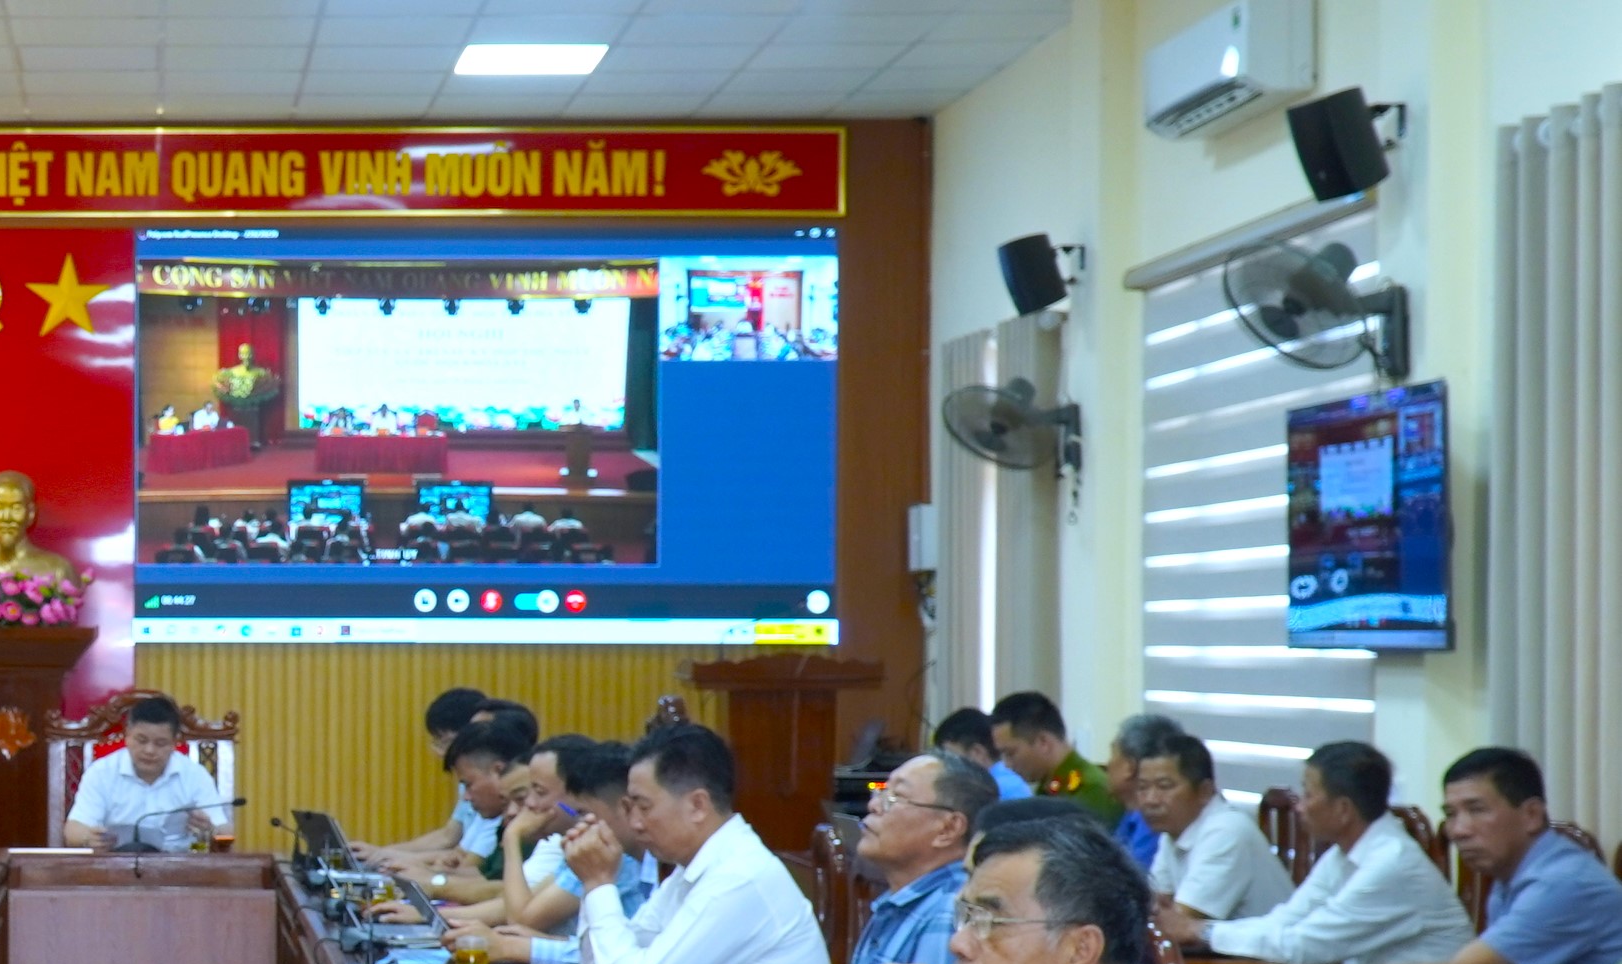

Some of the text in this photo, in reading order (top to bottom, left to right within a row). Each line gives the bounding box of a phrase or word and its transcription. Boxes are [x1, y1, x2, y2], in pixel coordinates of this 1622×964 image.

[65, 151, 159, 198] NAM
[171, 150, 306, 202] QUANG
[319, 150, 413, 197] VINH
[424, 141, 542, 197] MUÔN
[553, 139, 666, 197] NĂM!
